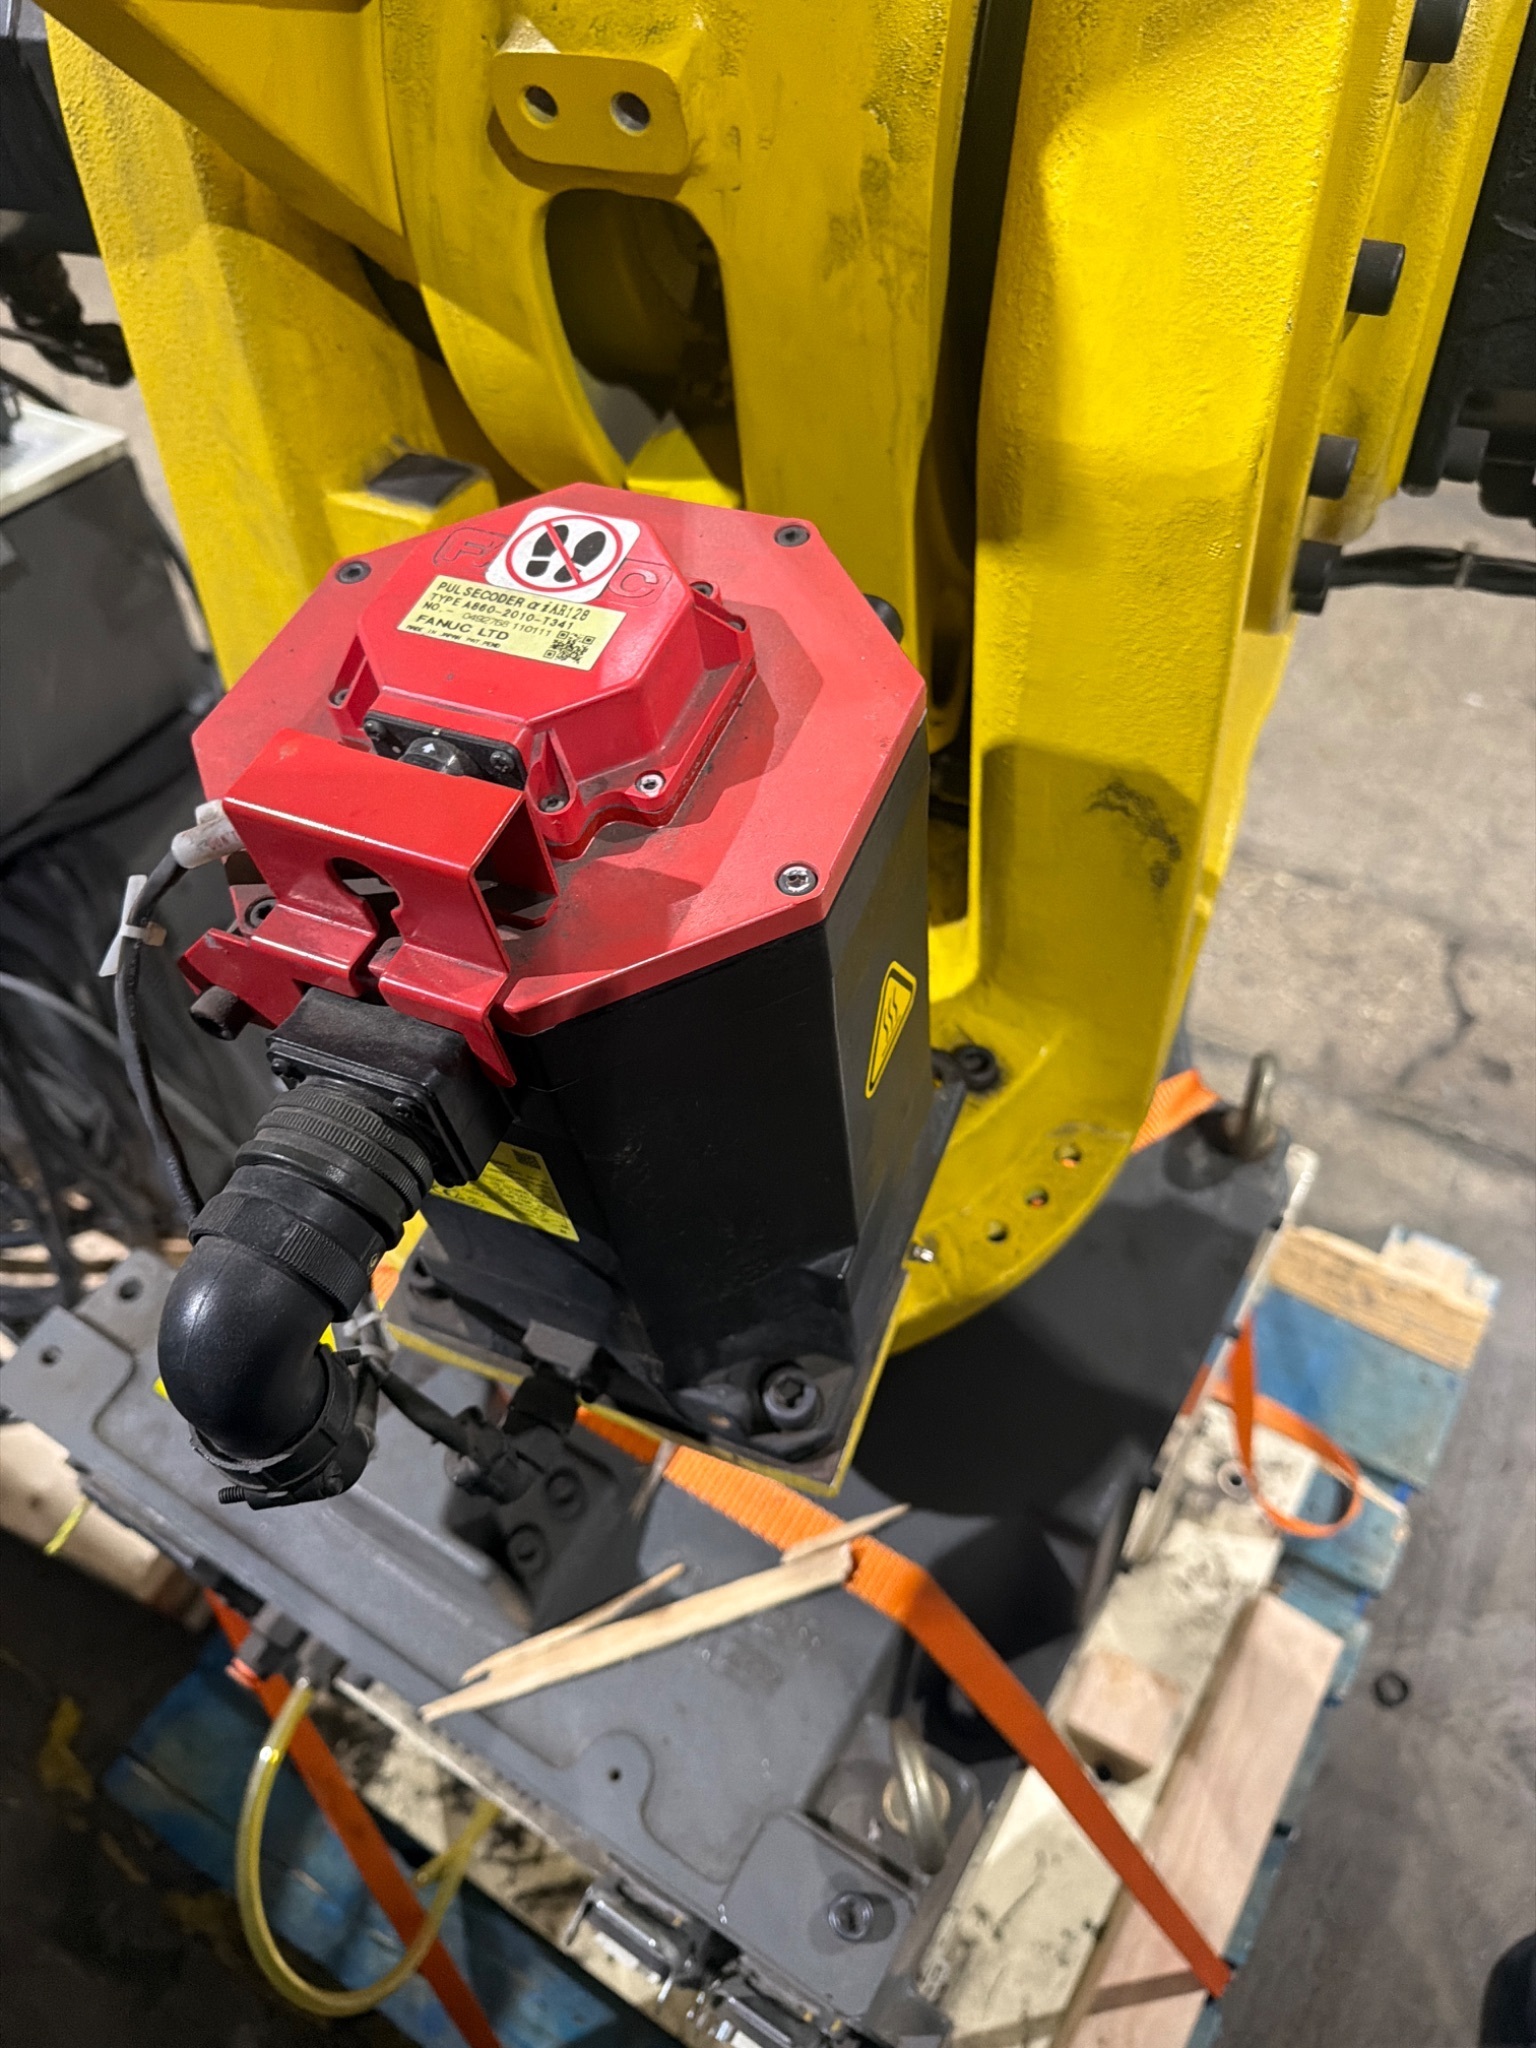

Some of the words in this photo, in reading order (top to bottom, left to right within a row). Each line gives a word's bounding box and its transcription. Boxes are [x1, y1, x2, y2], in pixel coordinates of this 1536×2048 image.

[437, 581, 525, 608] PULSECODER
[429, 592, 462, 606] TYPE
[462, 601, 573, 630] A860-2010-T341
[415, 614, 473, 633] FANUC
[477, 627, 509, 640] LTD
[439, 632, 462, 641] JAPAN
[513, 623, 552, 637] 110111
